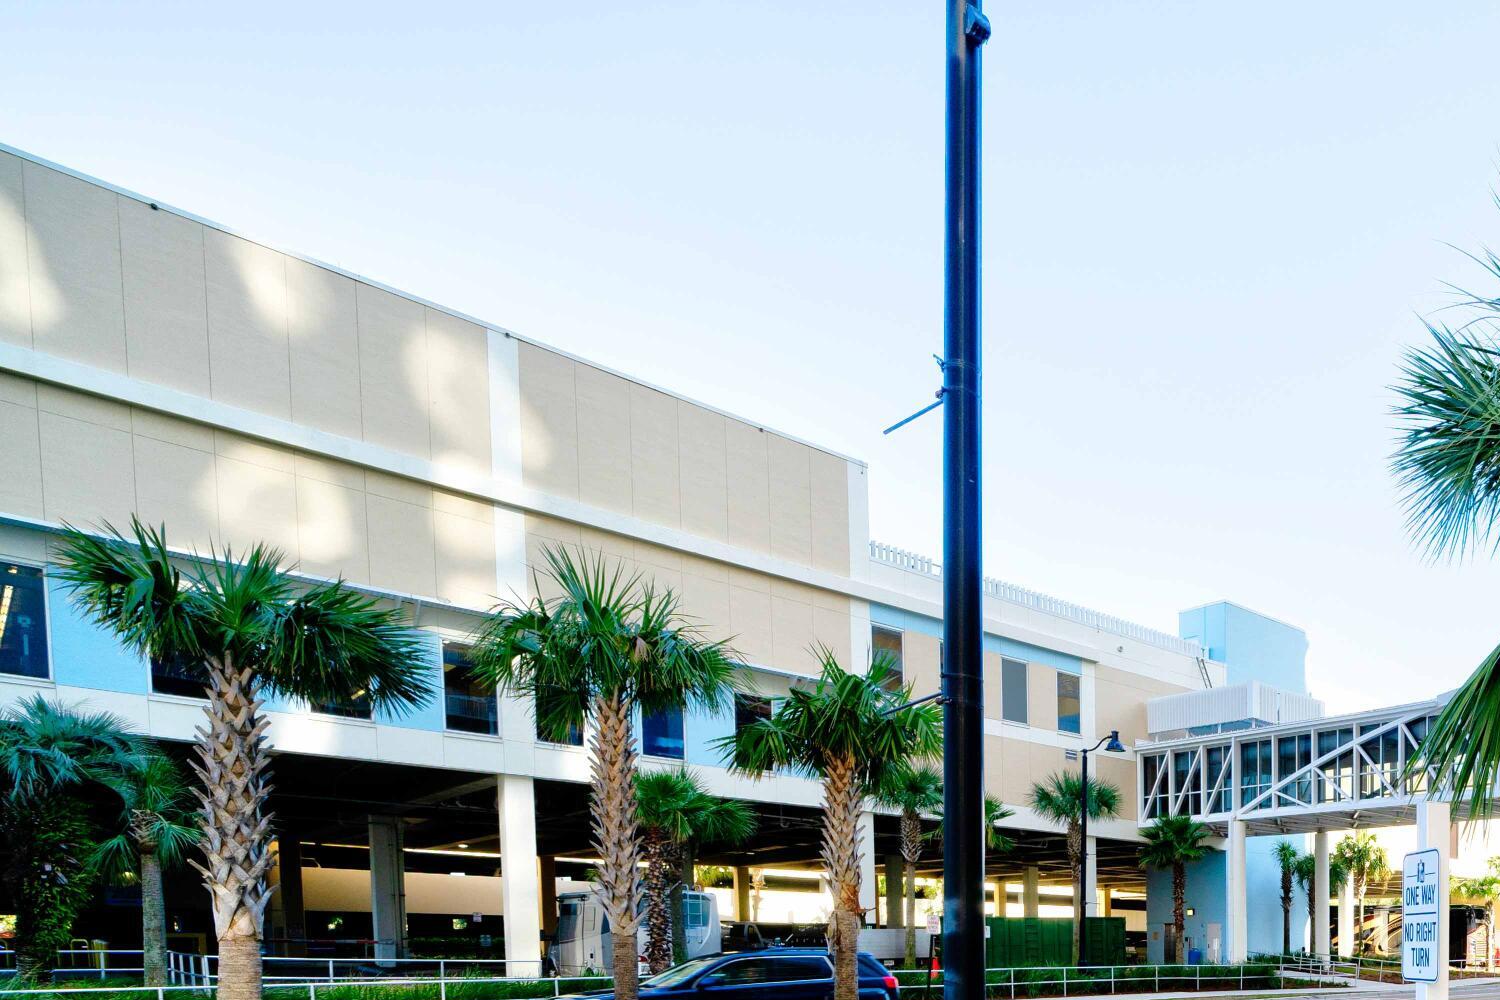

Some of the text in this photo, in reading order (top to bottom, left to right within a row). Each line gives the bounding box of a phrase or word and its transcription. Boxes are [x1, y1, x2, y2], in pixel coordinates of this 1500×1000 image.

[1406, 884, 1436, 906] ONE WAY
[1405, 922, 1436, 942] NO RIGHT
[1411, 947, 1429, 967] TURN
